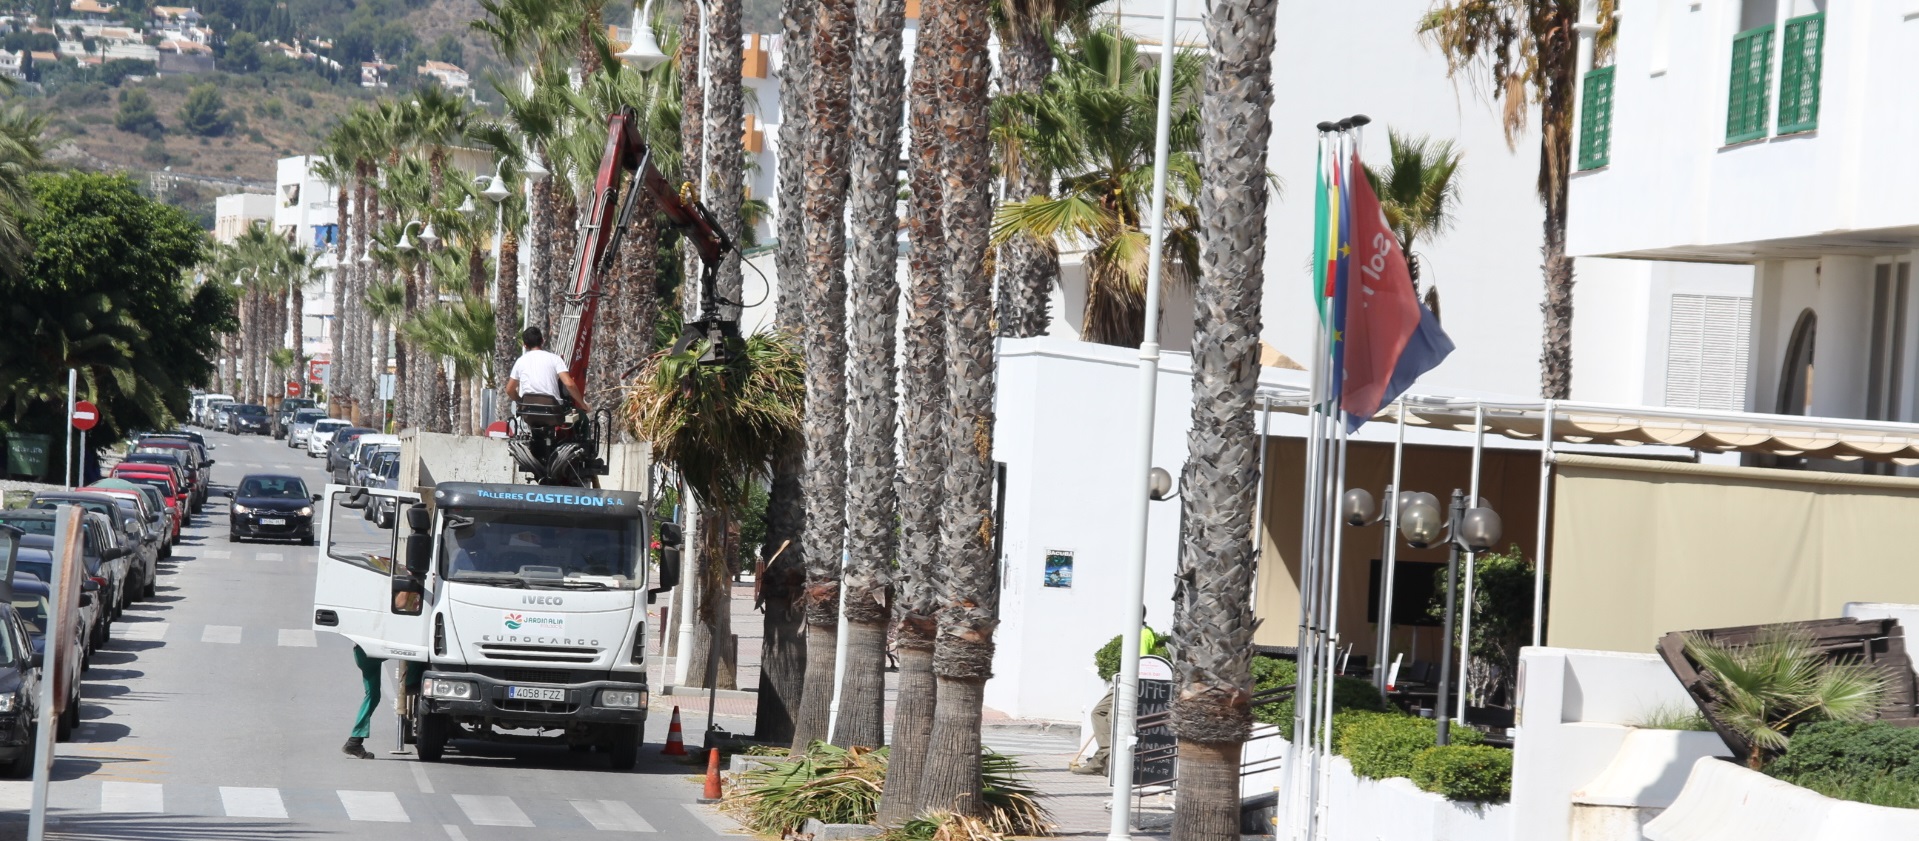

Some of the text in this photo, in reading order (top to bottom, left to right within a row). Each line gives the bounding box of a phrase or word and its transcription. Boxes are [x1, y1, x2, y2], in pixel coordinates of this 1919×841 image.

[477, 489, 524, 500] TALLERES
[526, 492, 604, 506] CASTEJON
[522, 595, 564, 606] IVECO
[482, 635, 599, 646] EUROCARGO
[517, 688, 561, 700] 4058 FZZ
